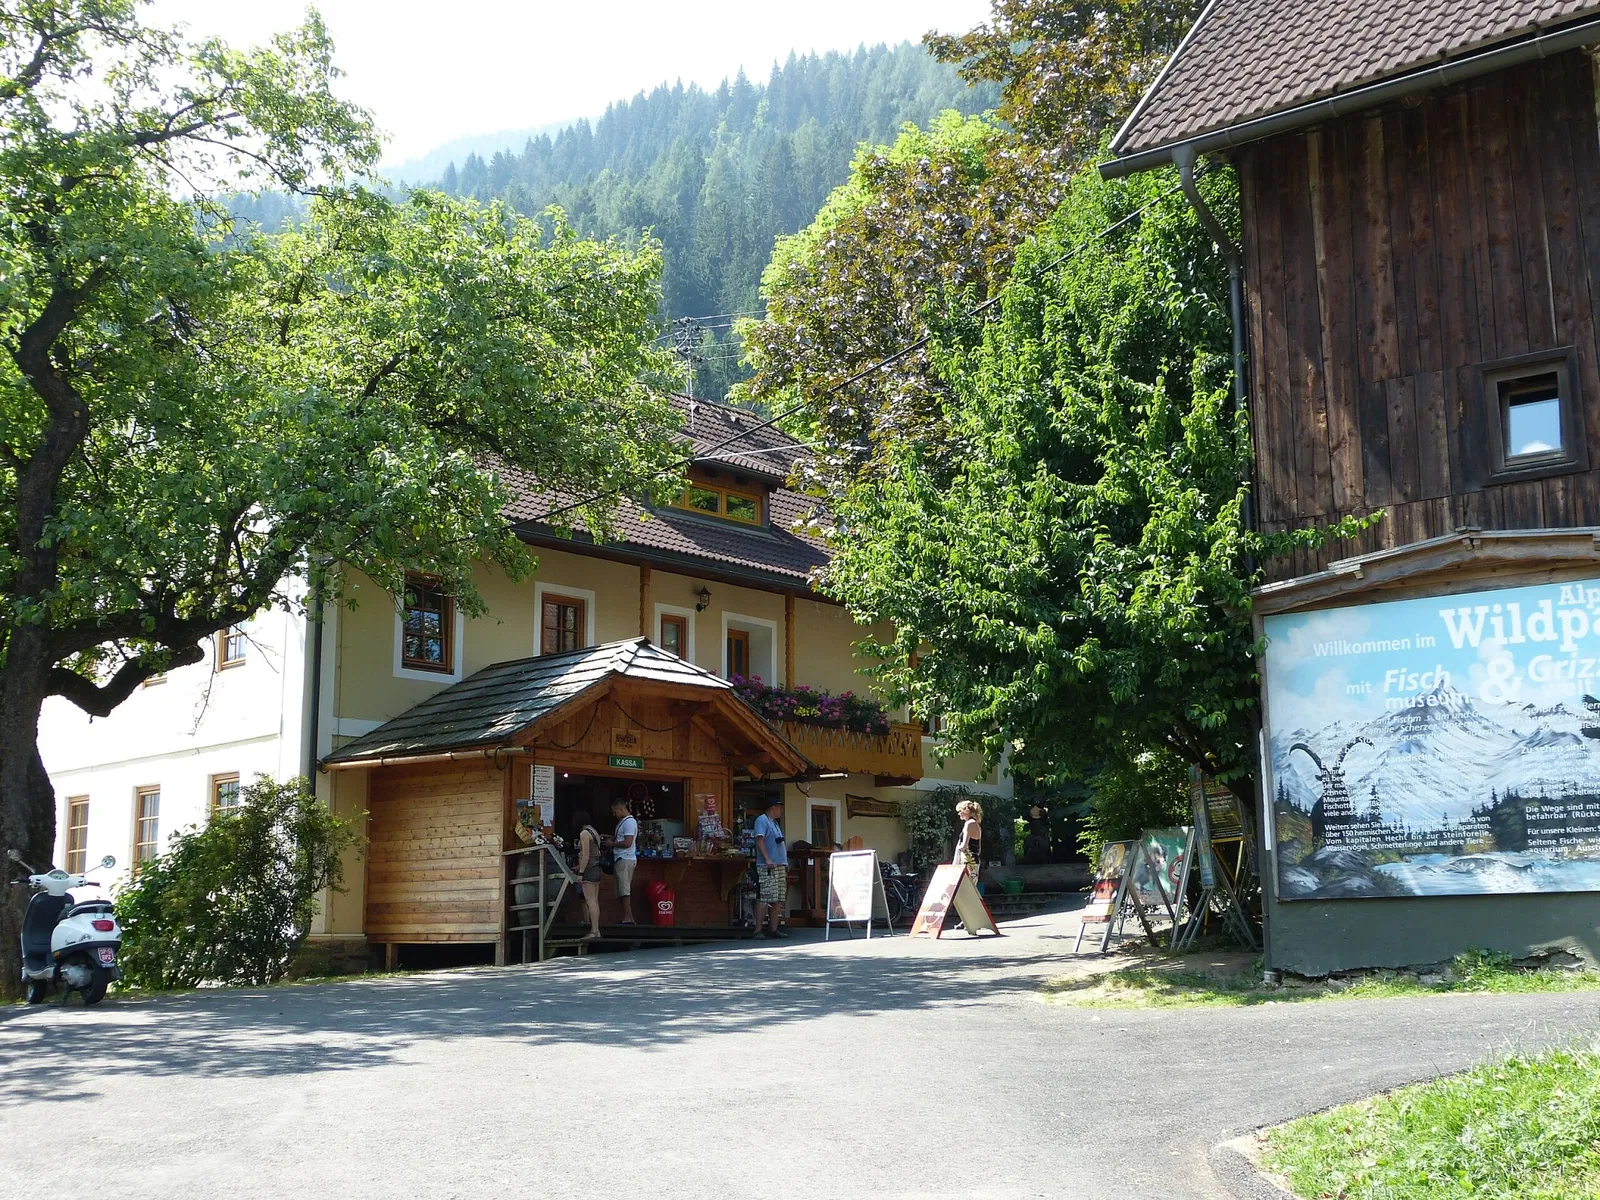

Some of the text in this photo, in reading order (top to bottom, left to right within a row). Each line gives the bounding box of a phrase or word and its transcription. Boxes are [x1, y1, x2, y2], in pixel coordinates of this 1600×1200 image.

[1313, 637, 1411, 657] Willkommen
[1416, 633, 1436, 649] im
[1346, 652, 1600, 704] mit Fisch & Griz
[1385, 690, 1473, 711] museum
[616, 758, 638, 767] KASSA
[1525, 802, 1600, 814] Die Wege sind mit
[1526, 812, 1567, 821] befahrbar
[1324, 823, 1350, 831] Weiters
[1351, 821, 1370, 829] sehen
[1371, 820, 1382, 828] Sie
[1527, 827, 1540, 835] Für
[1566, 825, 1597, 833] Kleinen:
[1325, 830, 1340, 838] über
[1342, 829, 1353, 837] 150
[1325, 837, 1342, 845] Vom
[1345, 835, 1382, 845] kapitalen
[1384, 833, 1408, 842] Hecht
[1411, 832, 1423, 840] bis
[1426, 832, 1441, 840] zur
[1371, 841, 1422, 850] Schmetterlinge
[1439, 838, 1465, 846] andere
[1466, 836, 1485, 844] Tiere
[1528, 838, 1557, 846] Seltene
